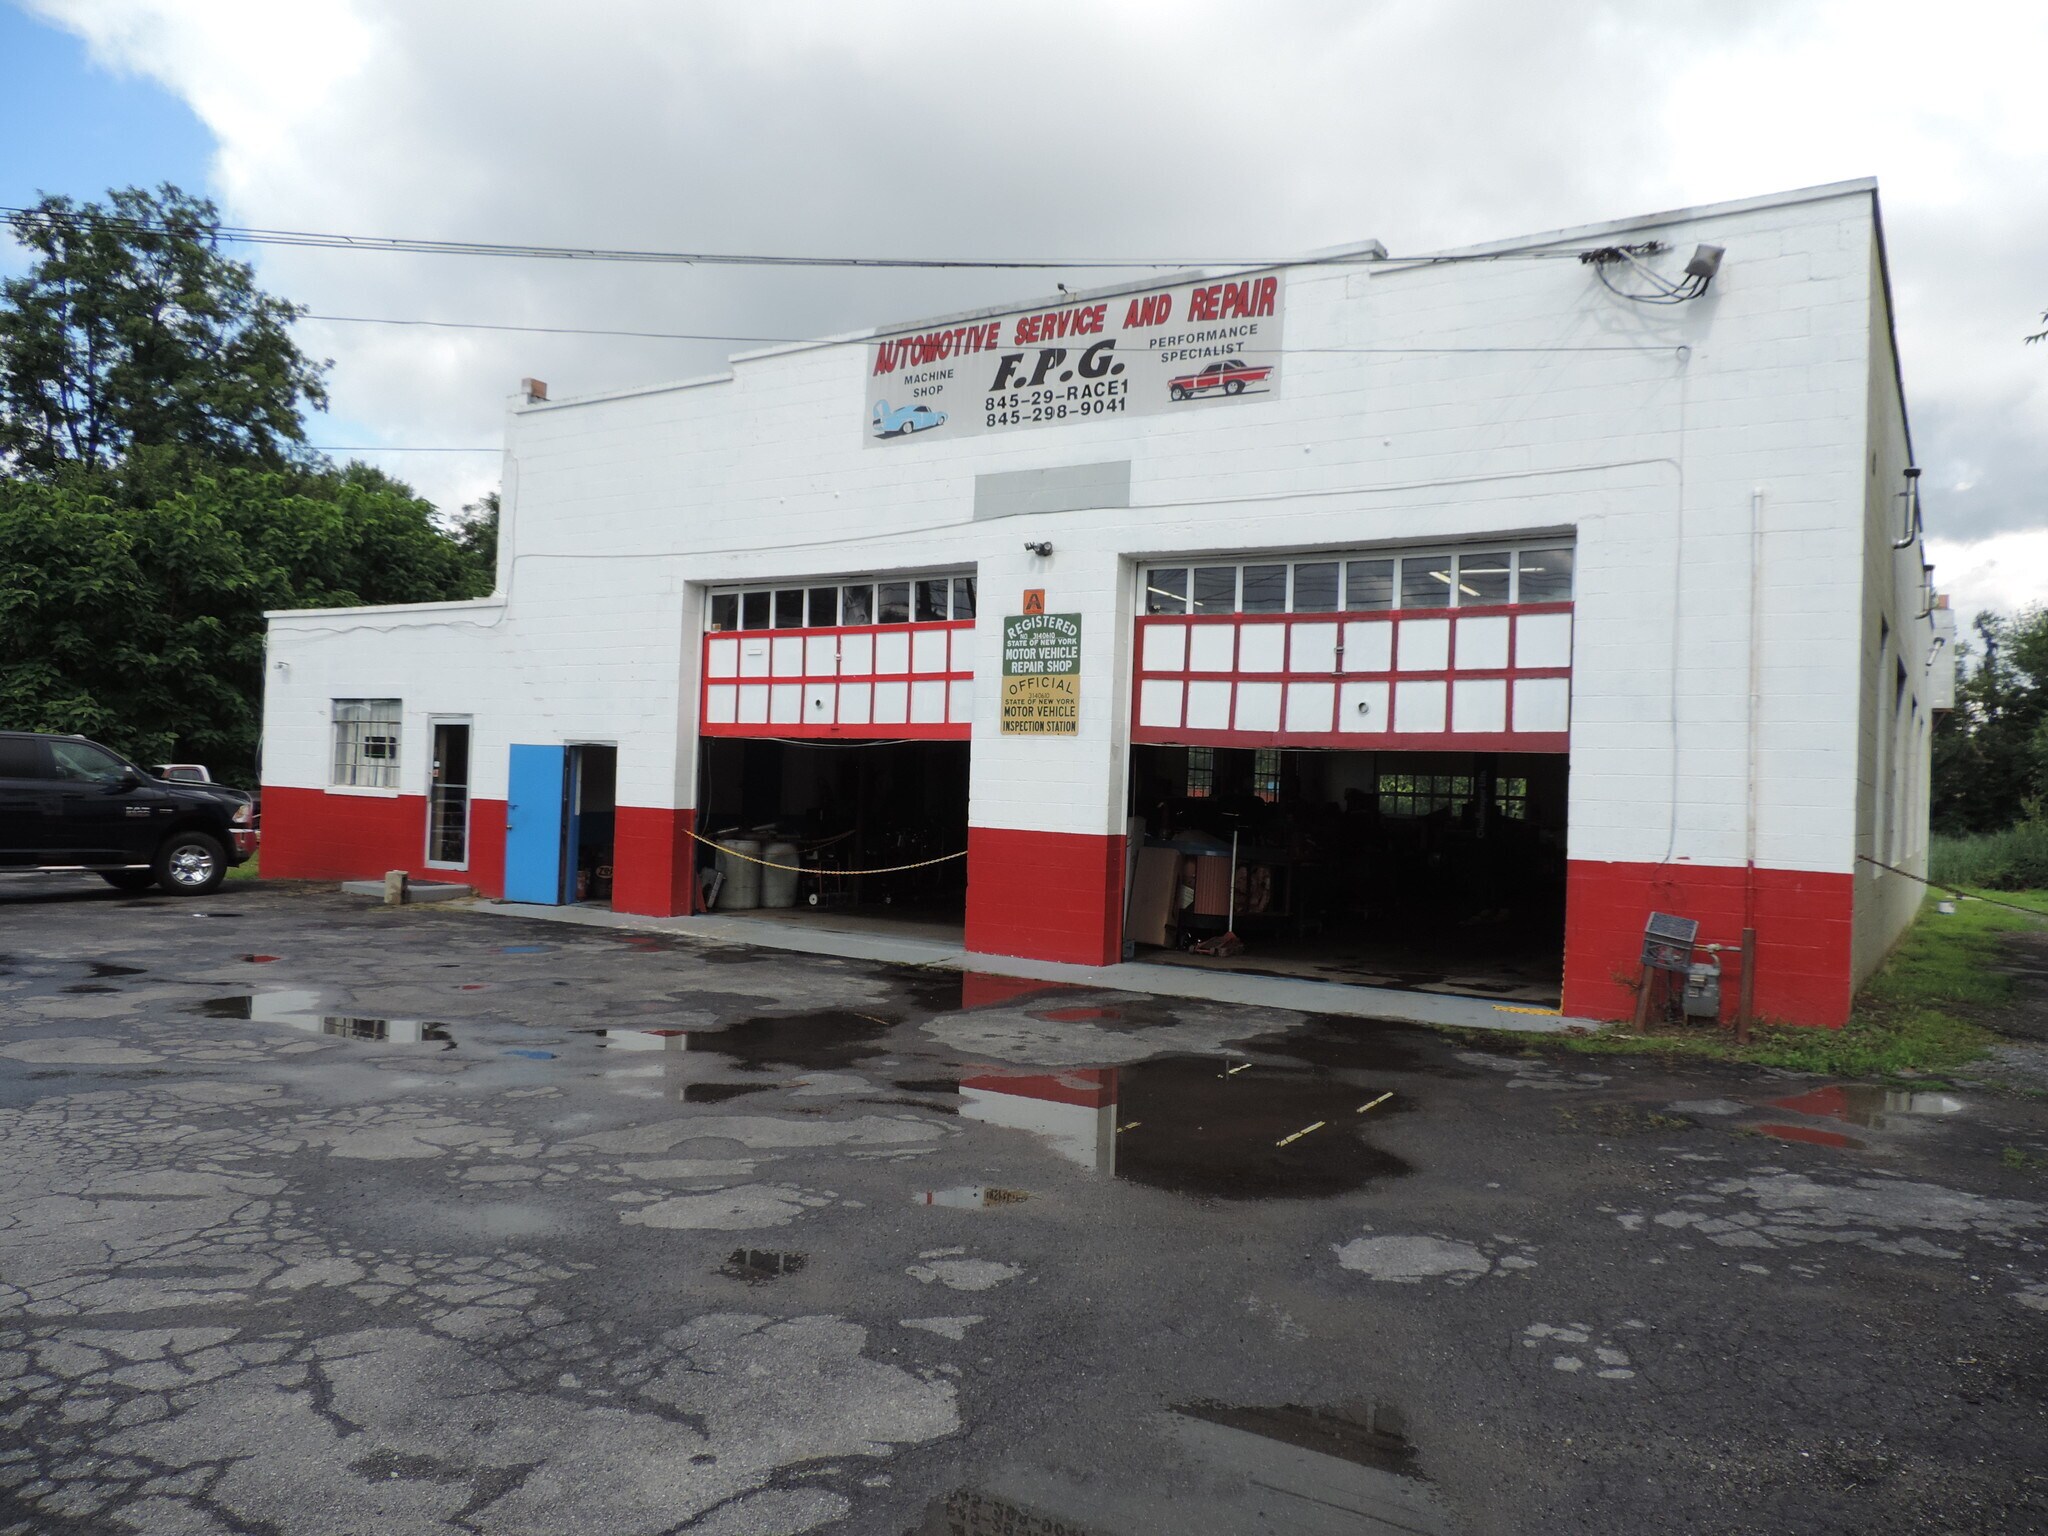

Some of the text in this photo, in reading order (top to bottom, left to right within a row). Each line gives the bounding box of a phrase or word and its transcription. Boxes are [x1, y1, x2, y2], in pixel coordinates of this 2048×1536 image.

[873, 276, 1278, 377] AUTOMOTIVE SERVICE AND REPAIR
[1150, 323, 1258, 349] PERFORMANCE
[1161, 342, 1244, 363] SPECIALIST
[988, 339, 1125, 392] F.P.G.
[904, 369, 954, 385] MACHINE
[913, 385, 944, 398] SHOP
[985, 378, 1128, 411] 845-29-RACE1
[986, 397, 1126, 427] 845-298-9041
[1026, 594, 1042, 610] A
[1007, 615, 1077, 639] REGISTERED
[1005, 646, 1078, 660] MOTOR VEHICLE
[1011, 660, 1073, 673] REPAIR SHOP
[1009, 676, 1073, 695] OFFICIAL
[1004, 705, 1076, 717] MOTOR VEHICLE
[1003, 720, 1076, 732] INSPECTION STATION
